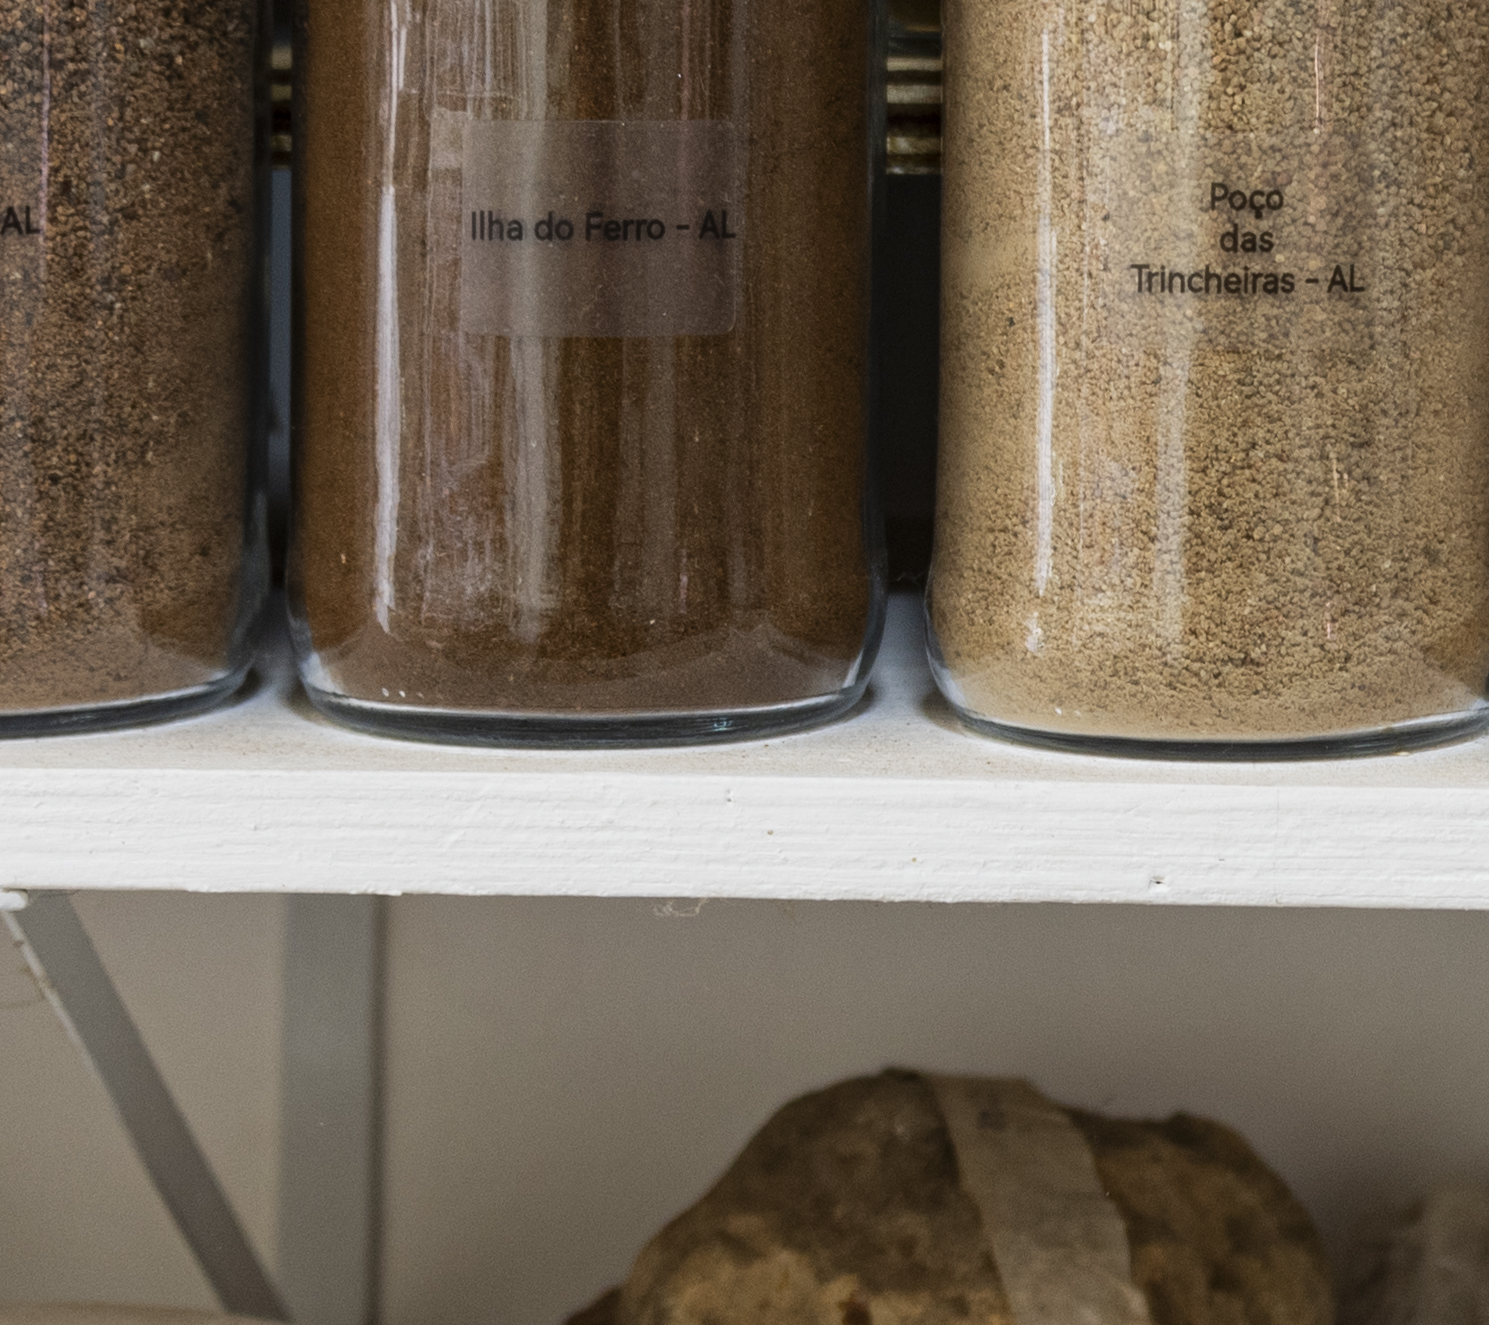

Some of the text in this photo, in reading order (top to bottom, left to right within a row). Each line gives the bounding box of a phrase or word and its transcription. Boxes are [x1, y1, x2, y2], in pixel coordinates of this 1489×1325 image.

[1210, 182, 1284, 220] Poço
[0, 205, 41, 236] AL
[471, 210, 523, 241] Ilha
[534, 210, 574, 242] do
[585, 210, 666, 242] Ferro
[699, 209, 736, 240] AL
[1219, 223, 1275, 253] das
[1130, 263, 1296, 295] Trincheiras
[1327, 263, 1365, 294] AL
